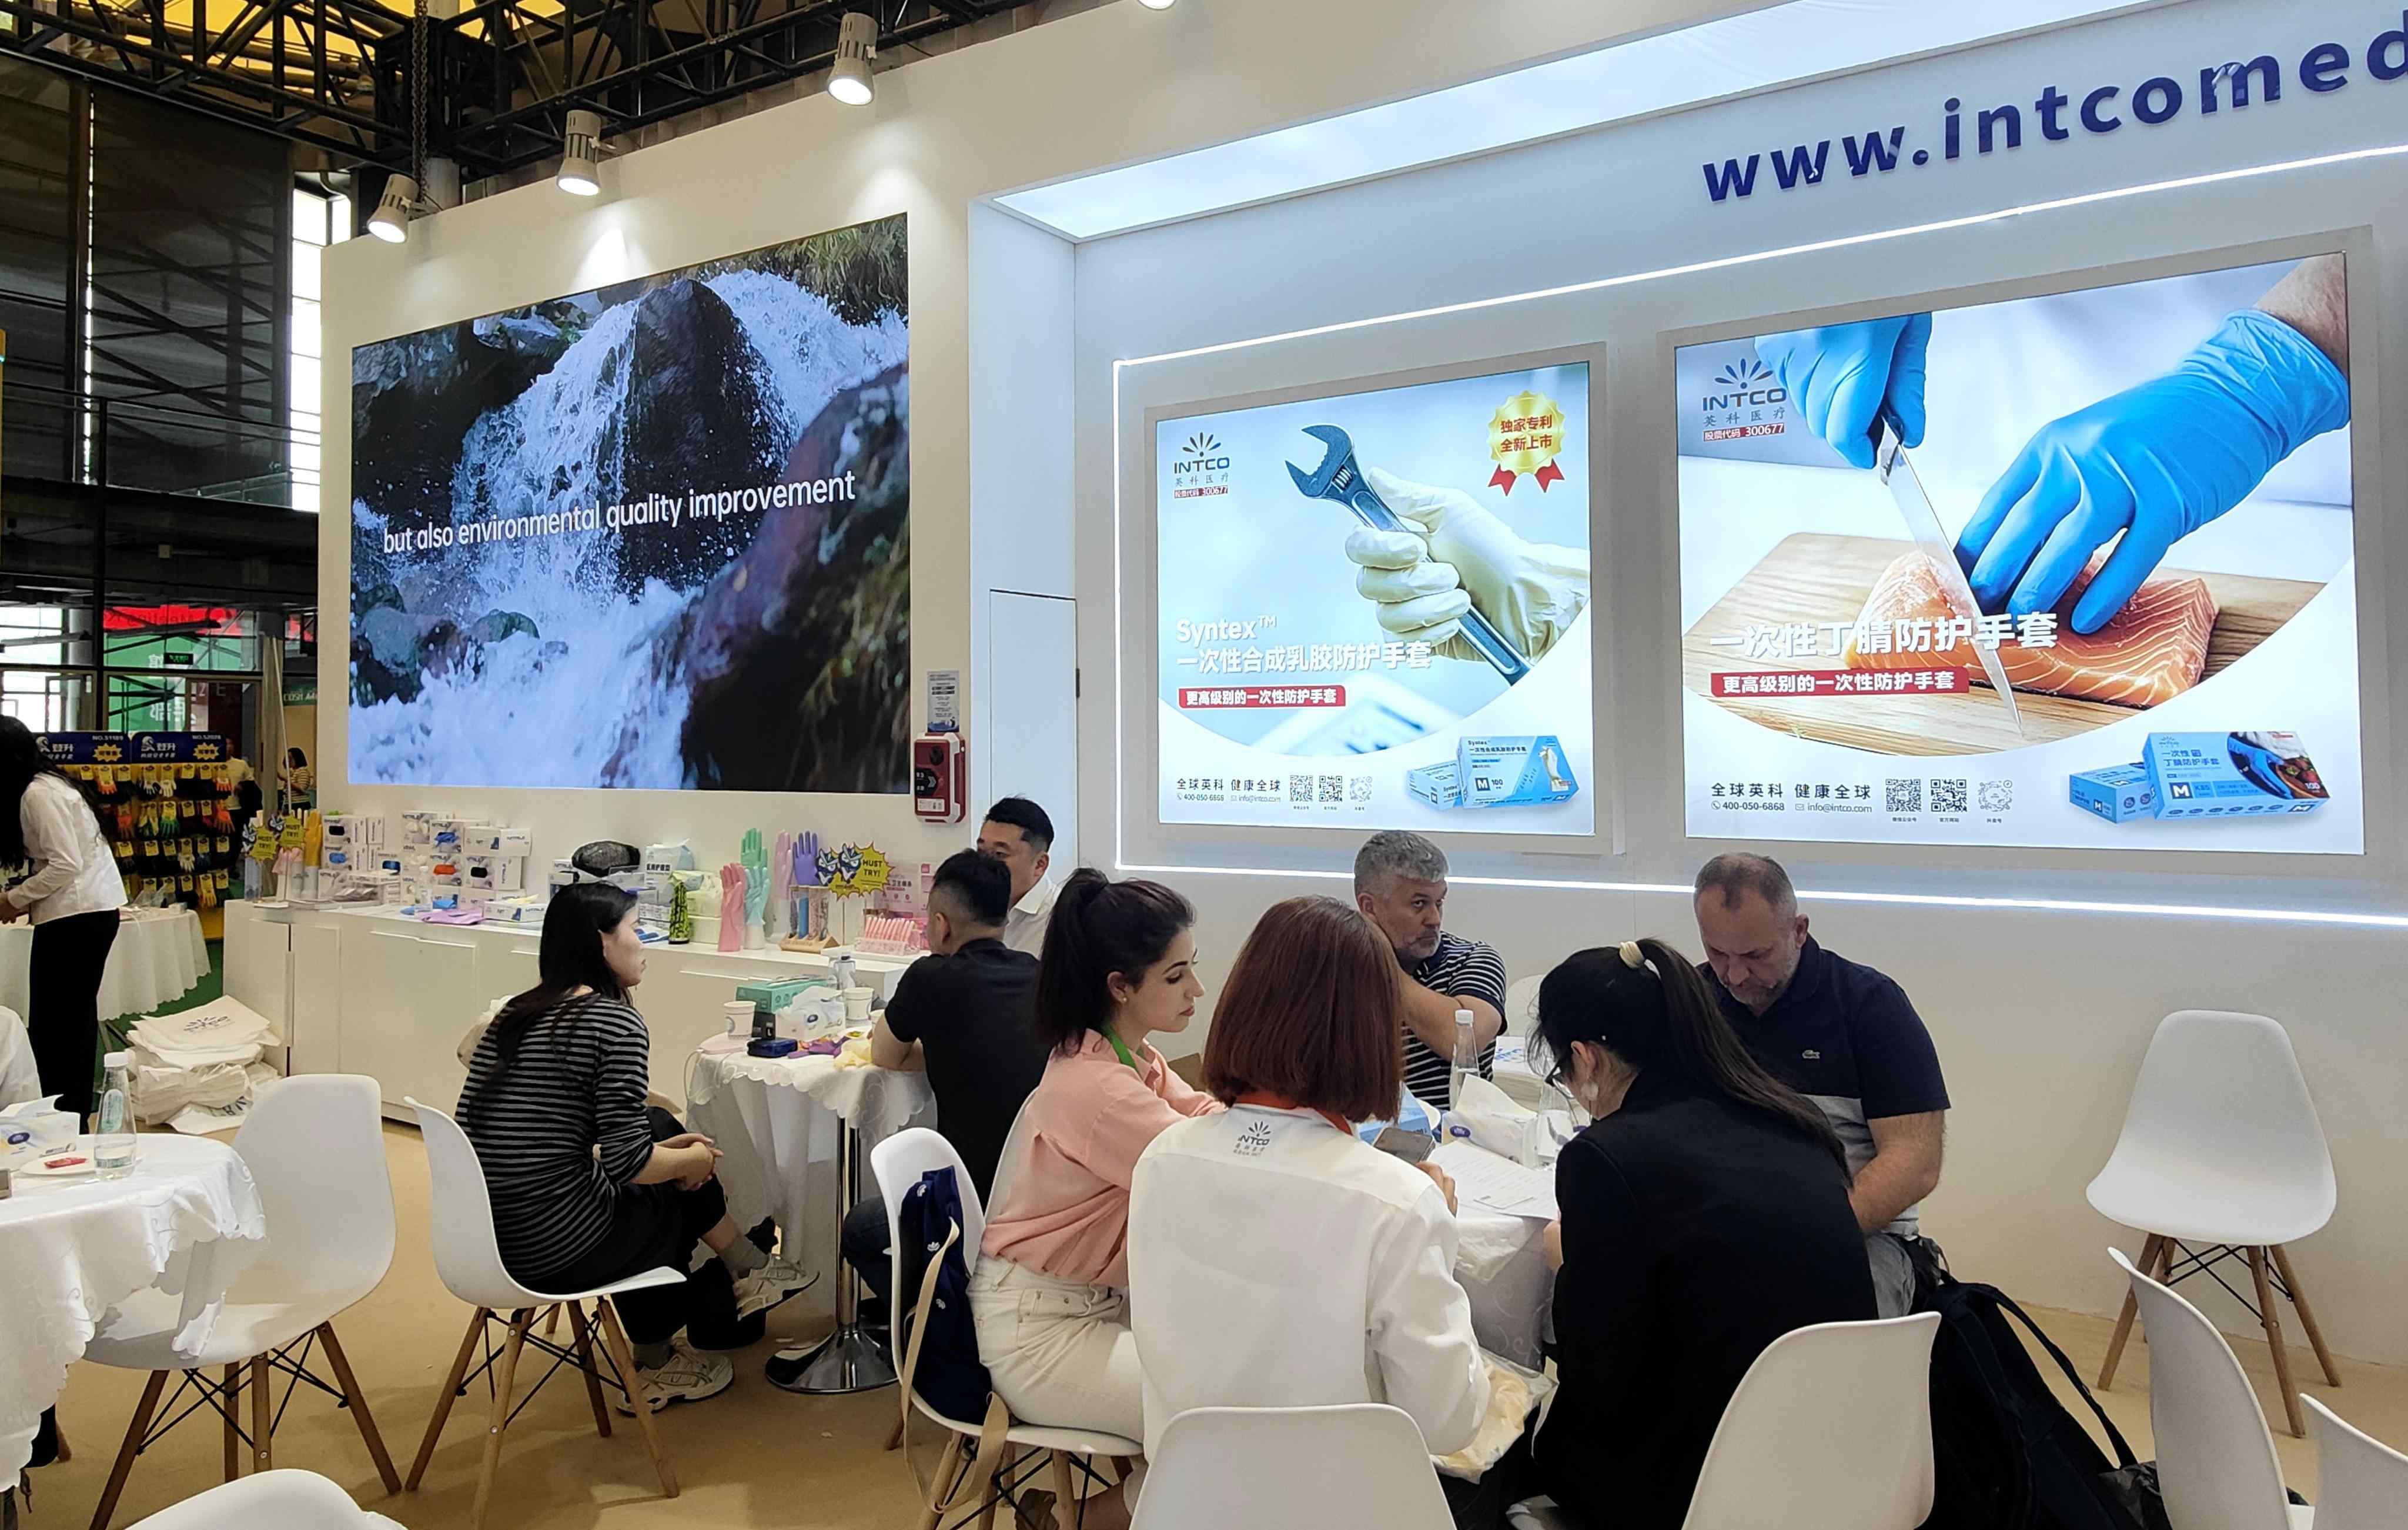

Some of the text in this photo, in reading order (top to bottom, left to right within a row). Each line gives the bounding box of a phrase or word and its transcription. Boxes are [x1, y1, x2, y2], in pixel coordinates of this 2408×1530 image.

[1702, 9, 2408, 202] www.intcomed
[1703, 387, 1787, 411] INTCO
[1500, 415, 1552, 433] 独家专利
[1703, 406, 1785, 427] 英科医疗
[1745, 423, 1784, 437] 300677
[1500, 434, 1552, 453] 全新上市
[1174, 457, 1230, 474] INTCO
[383, 470, 856, 554] but also environmental quality improvement
[1710, 611, 2058, 657] 一次性丁腈防护手套
[1177, 640, 1432, 674] 一次性合成乳胶防护手套
[1723, 671, 1955, 693] 更高级别的一次性防护手套
[1186, 689, 1336, 706] 更高级别的一次性防护手套
[1177, 778, 1280, 791] 全球英科 健康全球
[1711, 783, 1871, 800] 全球英科 健康全球
[2172, 785, 2190, 797] M
[1723, 801, 1872, 813] 400-050-6868 info@intco.com
[862, 859, 882, 868] MUST
[864, 869, 881, 877] TRY!
